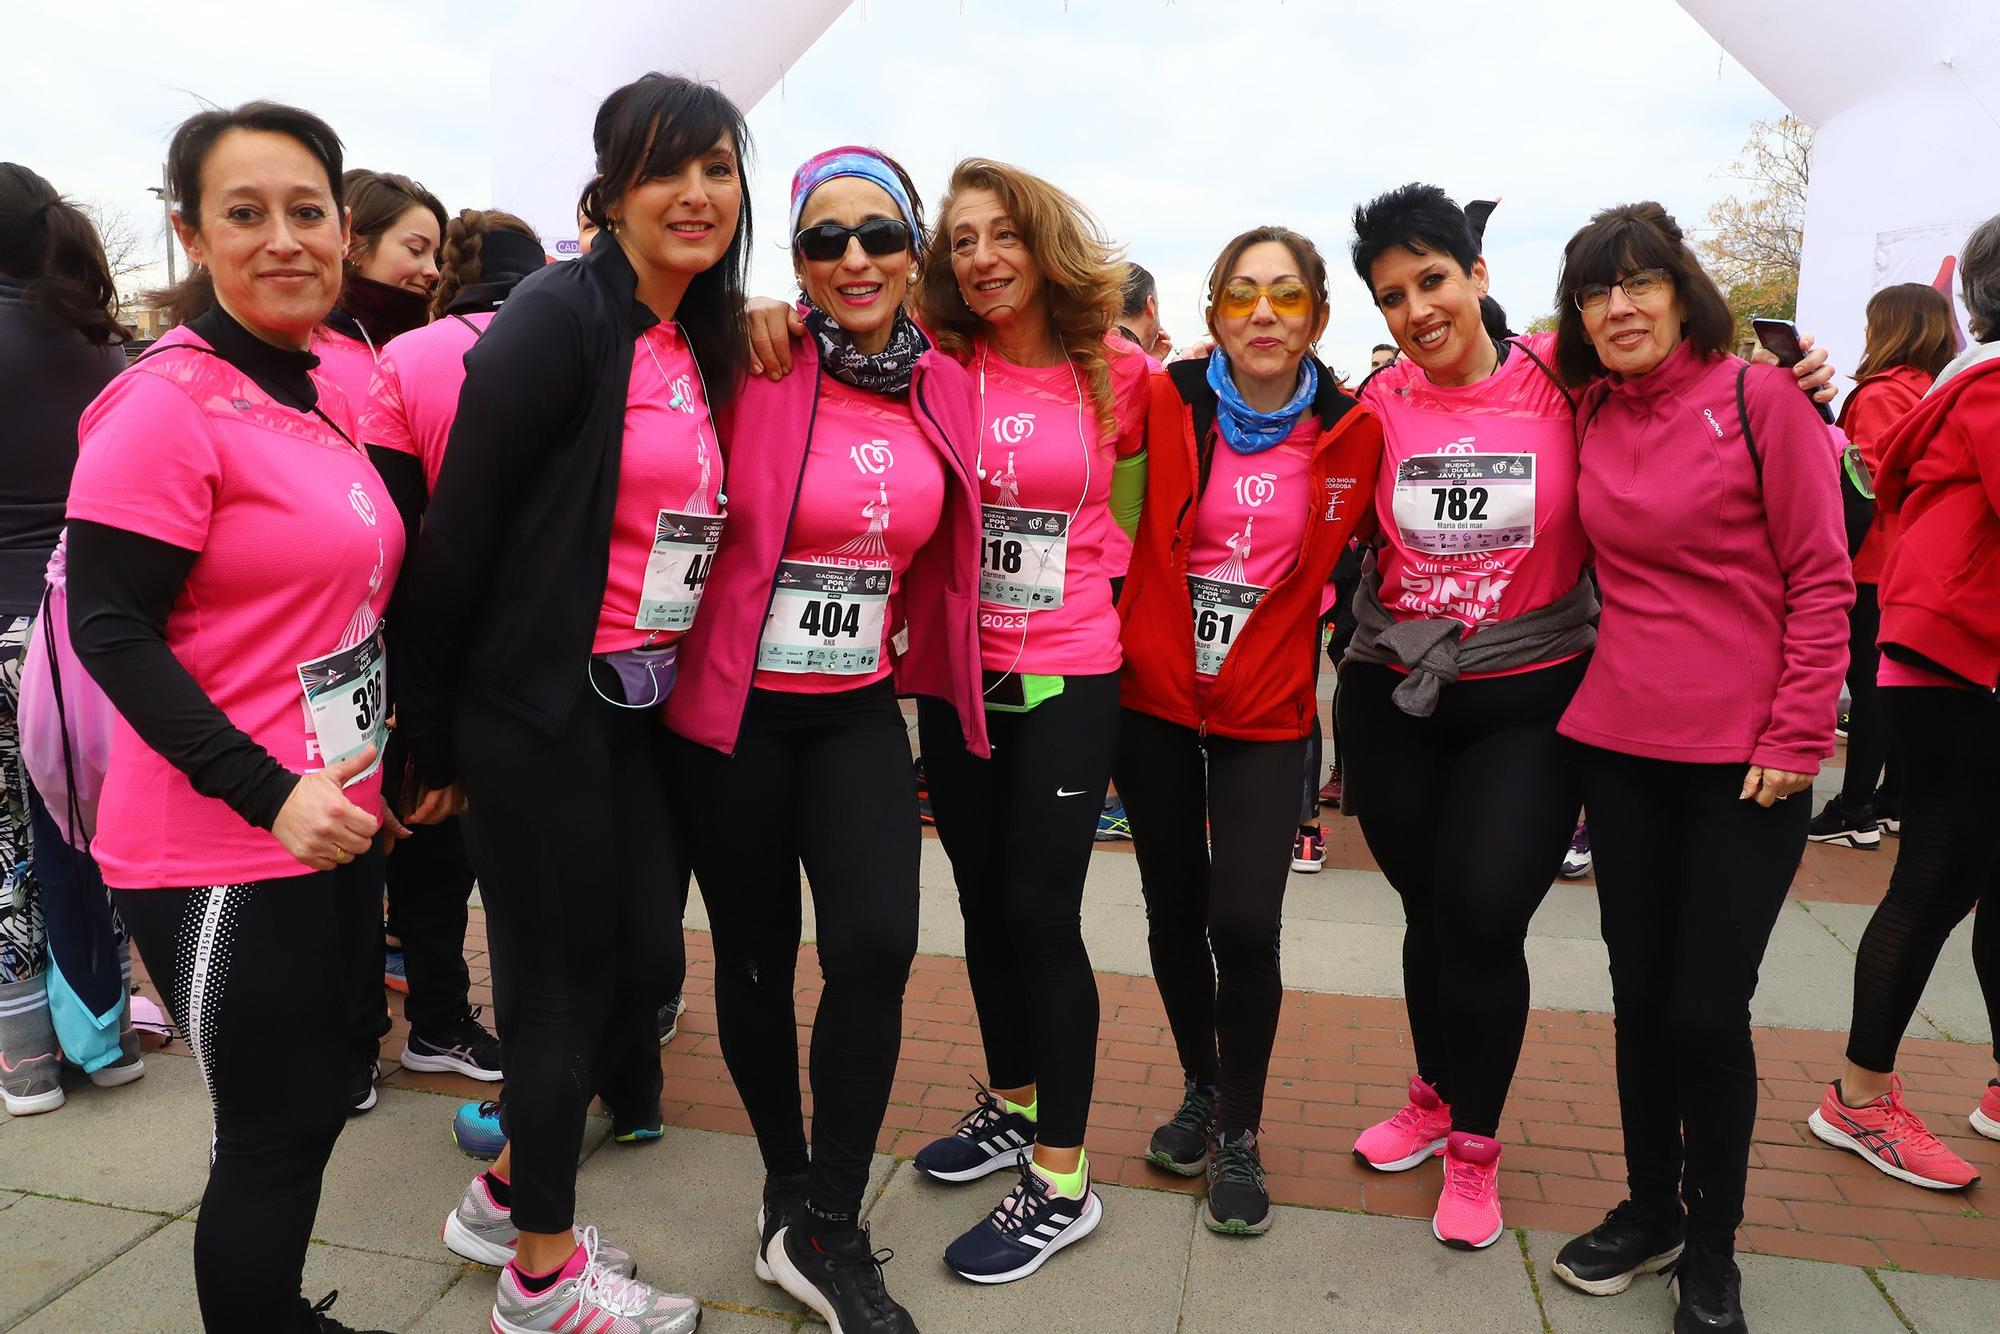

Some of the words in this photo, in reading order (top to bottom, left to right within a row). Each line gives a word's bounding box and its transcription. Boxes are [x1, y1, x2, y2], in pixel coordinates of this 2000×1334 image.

[558, 241, 579, 252] CAD
[1431, 486, 1489, 521] 782
[983, 512, 1006, 520] ADENA
[984, 522, 1010, 531] ELLAS
[1457, 521, 1468, 529] del
[683, 554, 712, 591] 44
[1415, 561, 1438, 573] VIII
[815, 572, 844, 581] CADENA
[982, 569, 1006, 581] Carmen
[827, 579, 844, 587] POR
[1197, 593, 1222, 603] ELLAS
[799, 600, 861, 638] 404
[981, 614, 1026, 629] 2023
[1193, 608, 1234, 645] 61
[352, 670, 381, 731] 336
[212, 894, 222, 906] IN
[199, 911, 217, 962] YOURSELF
[192, 972, 203, 1011] BELIEVE
